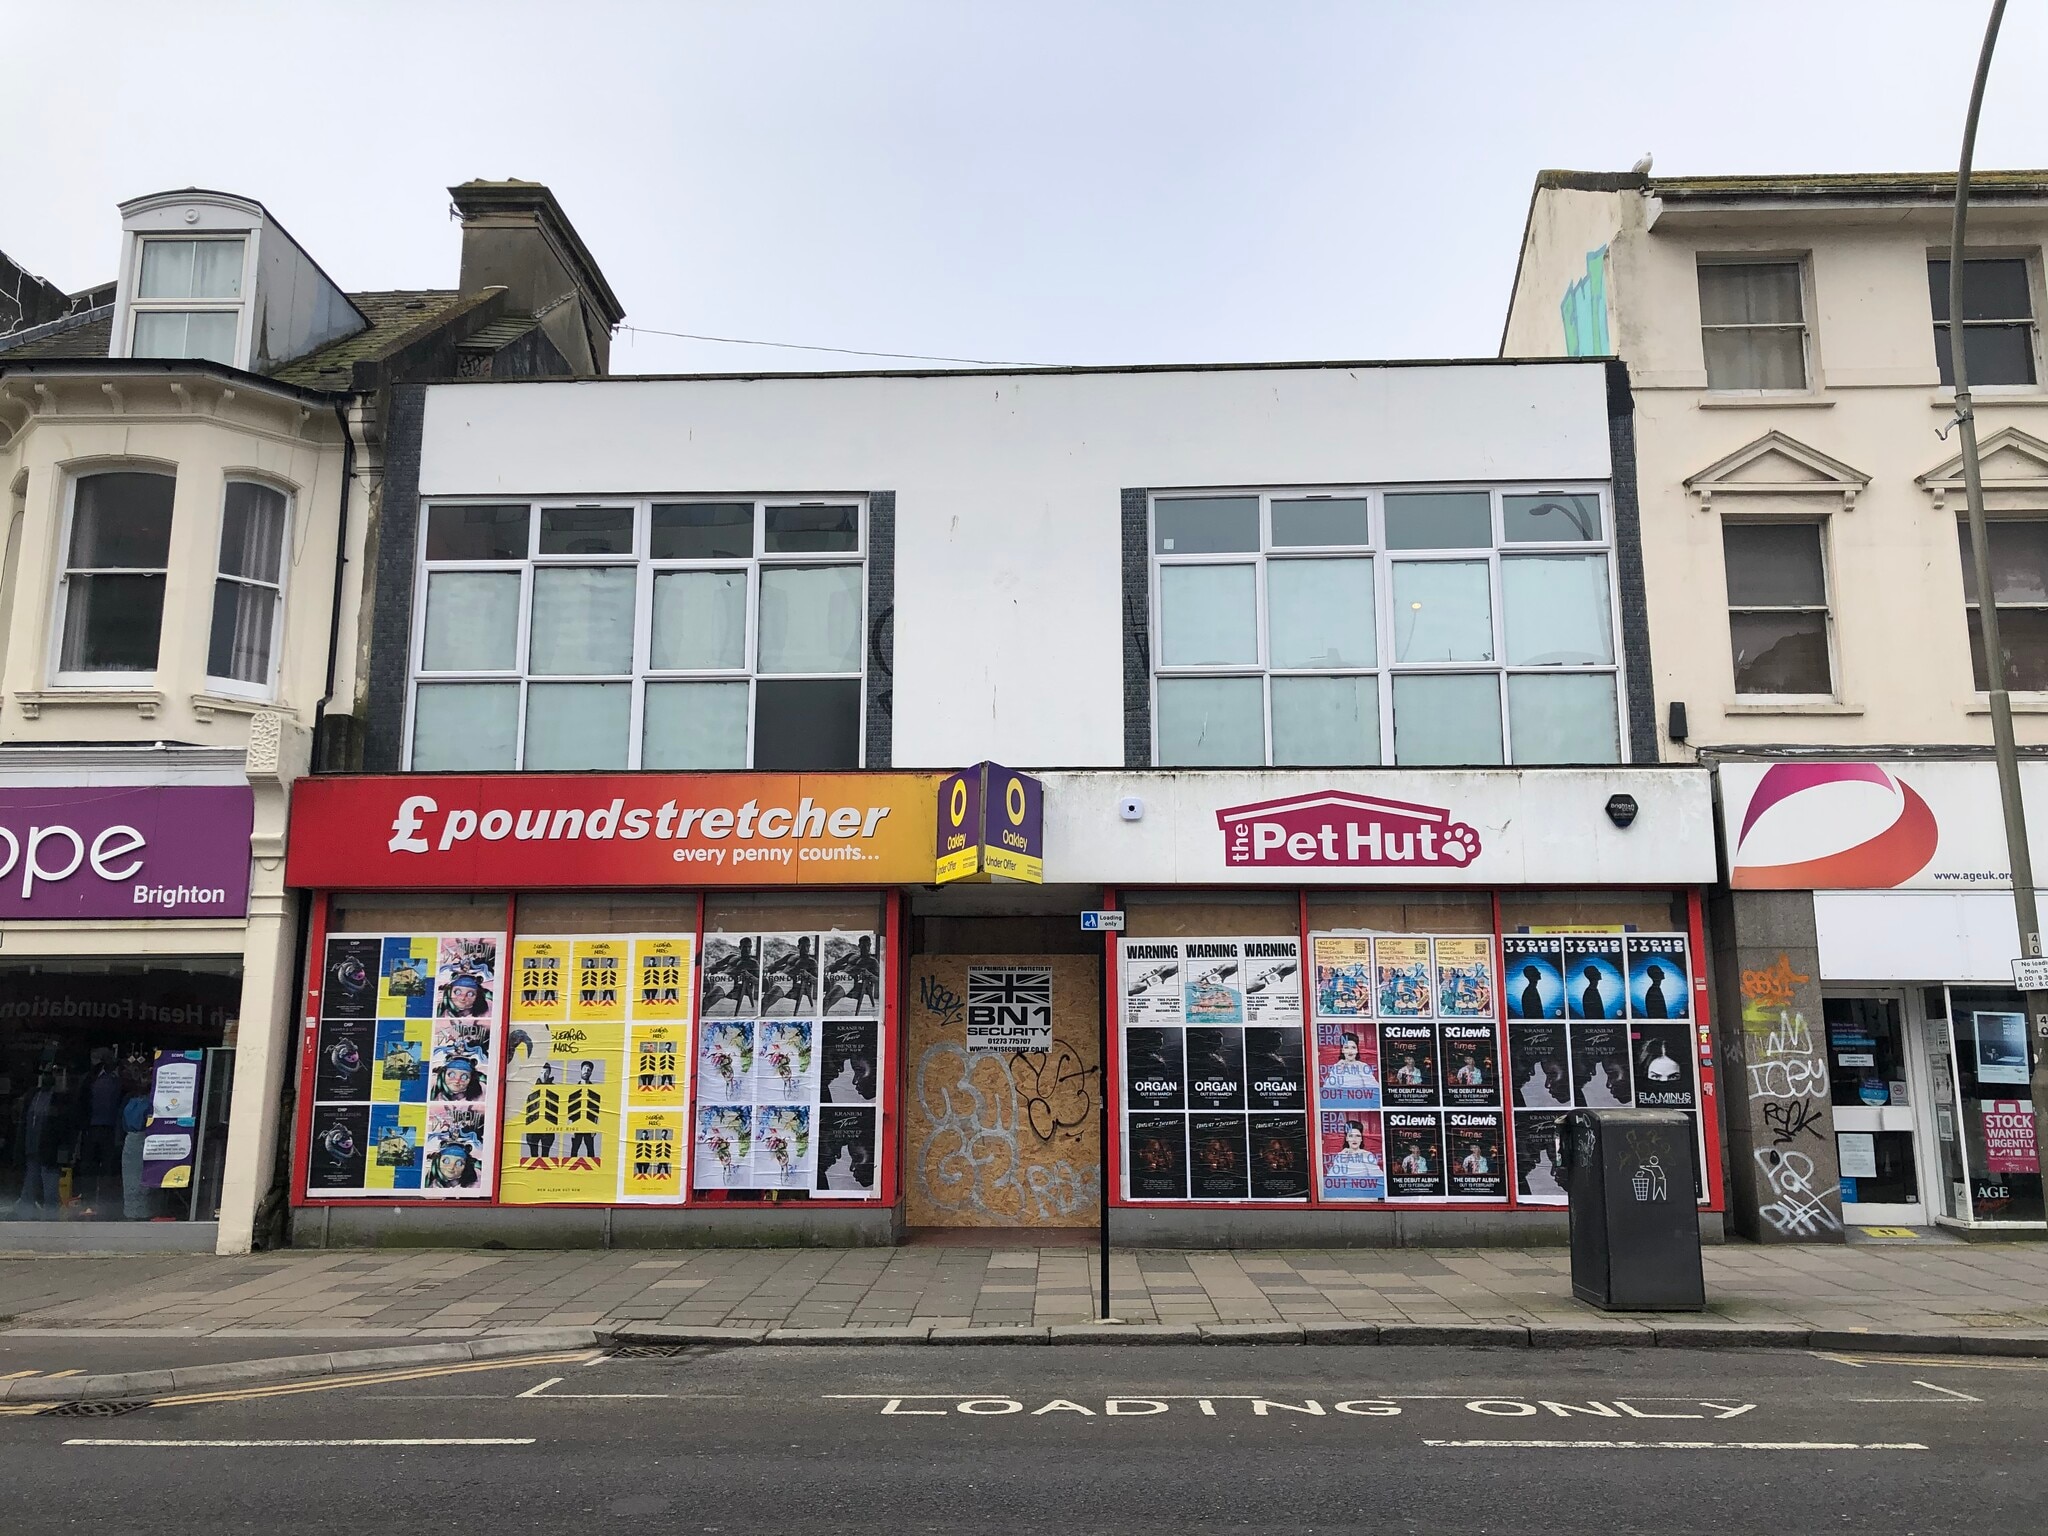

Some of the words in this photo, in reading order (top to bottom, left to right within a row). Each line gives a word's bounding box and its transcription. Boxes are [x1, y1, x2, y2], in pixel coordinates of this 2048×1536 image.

[947, 833, 967, 850] Oakley
[1002, 829, 1028, 852] Oakley
[1231, 823, 1249, 862] the
[1253, 823, 1339, 861] Pet
[1346, 822, 1439, 861] Hut
[673, 849, 726, 866] every
[732, 849, 792, 866] penny
[799, 845, 880, 861] counts...
[986, 856, 1002, 868] Under
[1003, 859, 1017, 870] Offer
[133, 885, 225, 908] Brighton
[1127, 945, 1179, 959] WARNING
[1186, 944, 1238, 958] WARNING
[1244, 943, 1297, 957] WARNING
[968, 1006, 1051, 1026] BN1
[967, 1027, 1052, 1036] SECURITY
[1318, 1025, 1340, 1035] EDA
[1385, 1027, 1400, 1037] SG
[1402, 1027, 1431, 1037] Lewis
[1445, 1027, 1460, 1037] SG
[1461, 1027, 1491, 1037] Lewis
[1318, 1036, 1348, 1046] EREN
[1394, 1042, 1417, 1050] times
[1454, 1042, 1476, 1050] times
[1320, 1065, 1360, 1075] DREAM
[1363, 1065, 1377, 1075] OF
[1135, 1081, 1177, 1091] ORGAN
[1194, 1081, 1237, 1091] ORGAN
[1254, 1081, 1297, 1091] ORGAN
[1321, 1076, 1344, 1086] YOU
[1321, 1089, 1345, 1099] OUT
[1350, 1089, 1374, 1099] NOW
[1639, 1092, 1656, 1100] ELA
[1659, 1092, 1691, 1100] MINUS
[1321, 1112, 1345, 1123] EDA
[1390, 1114, 1405, 1126] SG
[1406, 1114, 1436, 1126] Lewis
[1451, 1114, 1466, 1126] SG
[1467, 1114, 1497, 1126] Lewis
[1985, 1115, 2033, 1128] STOCK
[1322, 1123, 1353, 1134] EREN
[1399, 1130, 1422, 1139] times
[1460, 1130, 1483, 1139] times
[1986, 1129, 2034, 1139] WANTED
[1987, 1139, 2035, 1148] URGENTLY
[1323, 1154, 1364, 1164] DREAM
[1367, 1154, 1382, 1164] OF
[1325, 1165, 1348, 1175] YOU
[1325, 1178, 1347, 1188] OUT
[1351, 1178, 1378, 1188] NOW
[1977, 1186, 2010, 1198] AGE
[880, 1399, 1402, 1417] LOADING
[1465, 1400, 1758, 1419] ONLY
